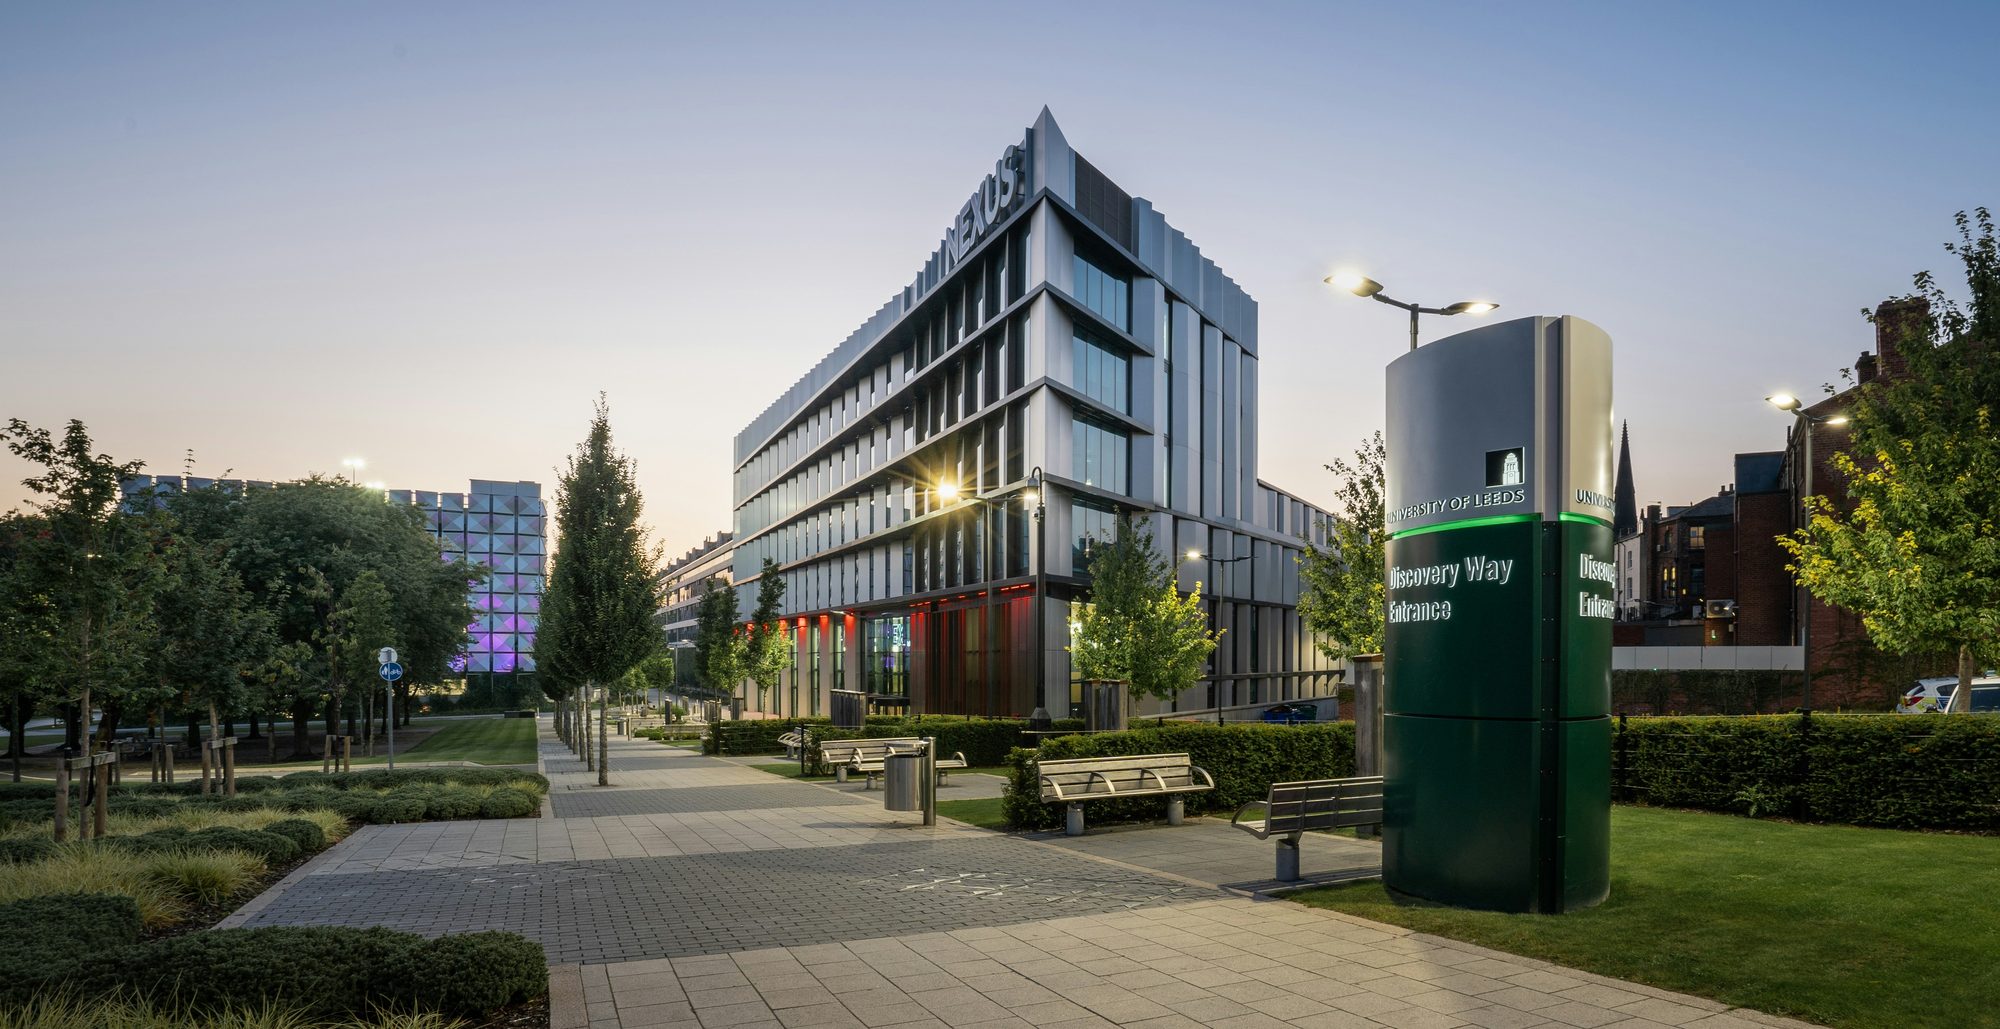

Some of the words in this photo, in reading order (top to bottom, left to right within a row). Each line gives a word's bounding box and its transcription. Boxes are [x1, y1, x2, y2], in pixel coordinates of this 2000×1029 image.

[945, 144, 1017, 275] NEXUS
[1386, 499, 1446, 524] UNIVERSITY
[1449, 495, 1470, 511] OF
[1473, 489, 1525, 508] LEEDS
[1389, 562, 1460, 590] Discovery
[1463, 555, 1513, 584] Way
[1389, 600, 1452, 624] Entrance
